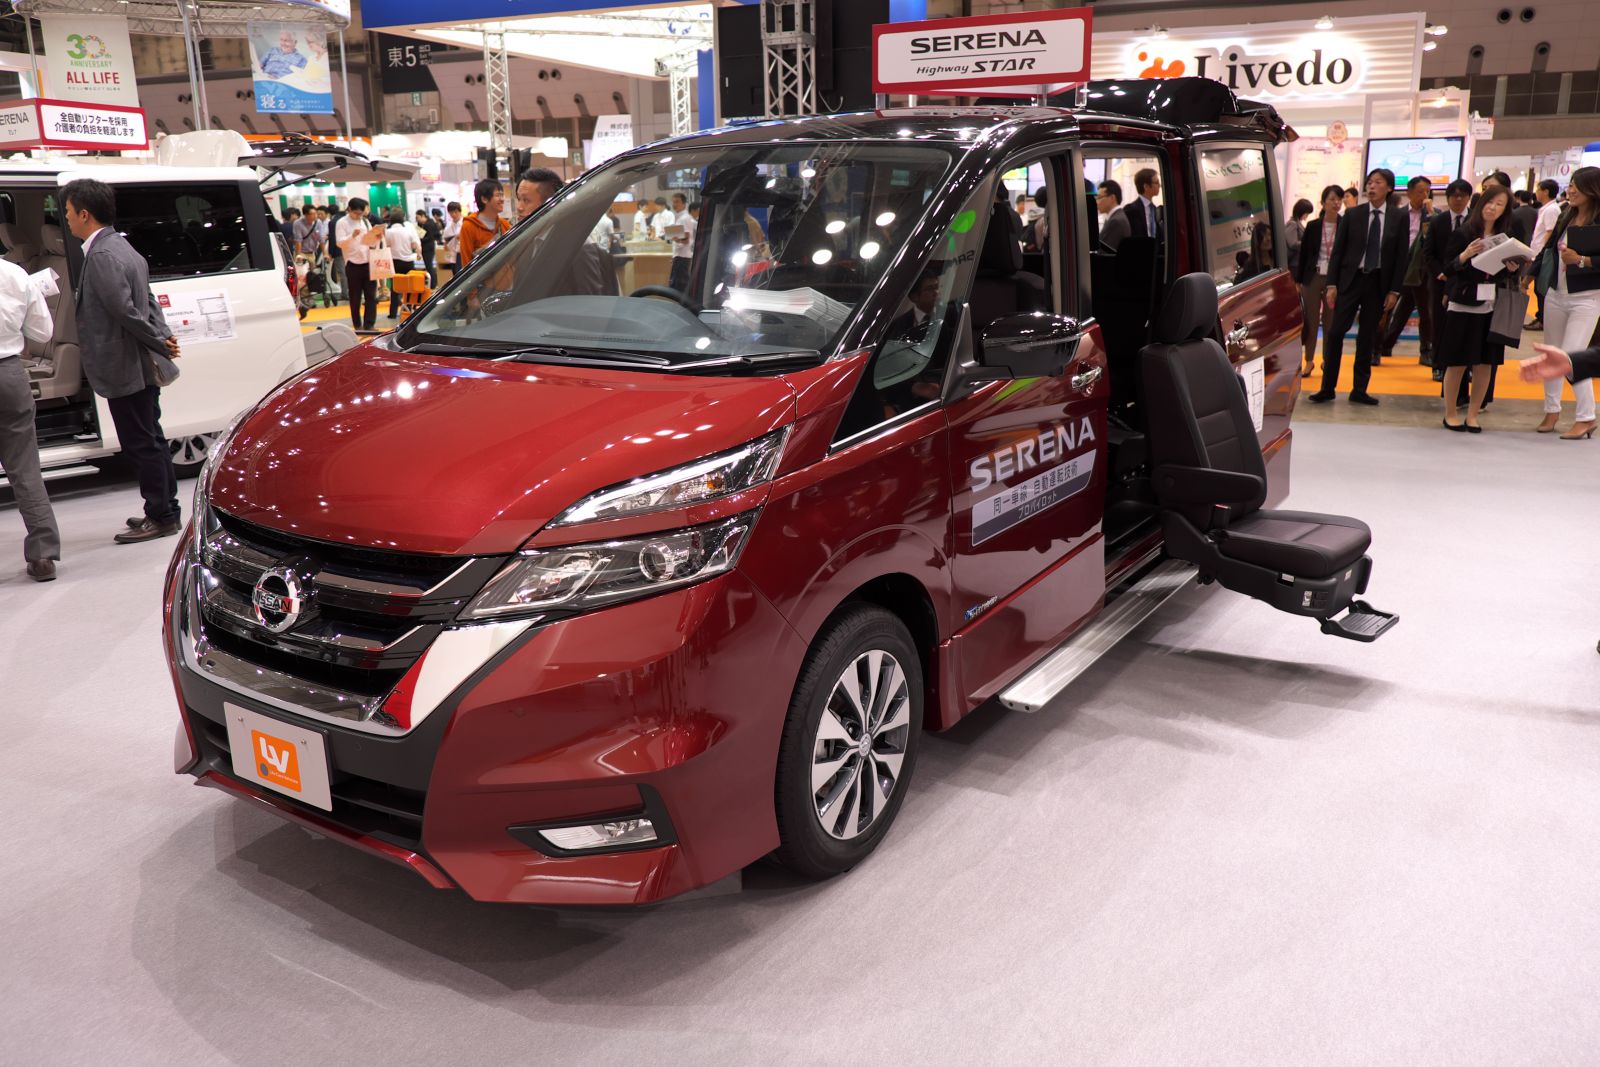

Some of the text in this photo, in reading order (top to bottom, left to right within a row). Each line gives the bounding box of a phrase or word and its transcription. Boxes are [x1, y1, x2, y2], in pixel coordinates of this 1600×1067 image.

[910, 29, 1047, 54] SERENA
[70, 60, 112, 68] ANNIVERSARY
[916, 57, 1036, 76] Highway STAR
[1194, 49, 1353, 90] Livedo
[66, 71, 120, 85] ALL LIFE
[969, 416, 1096, 493] SERENA
